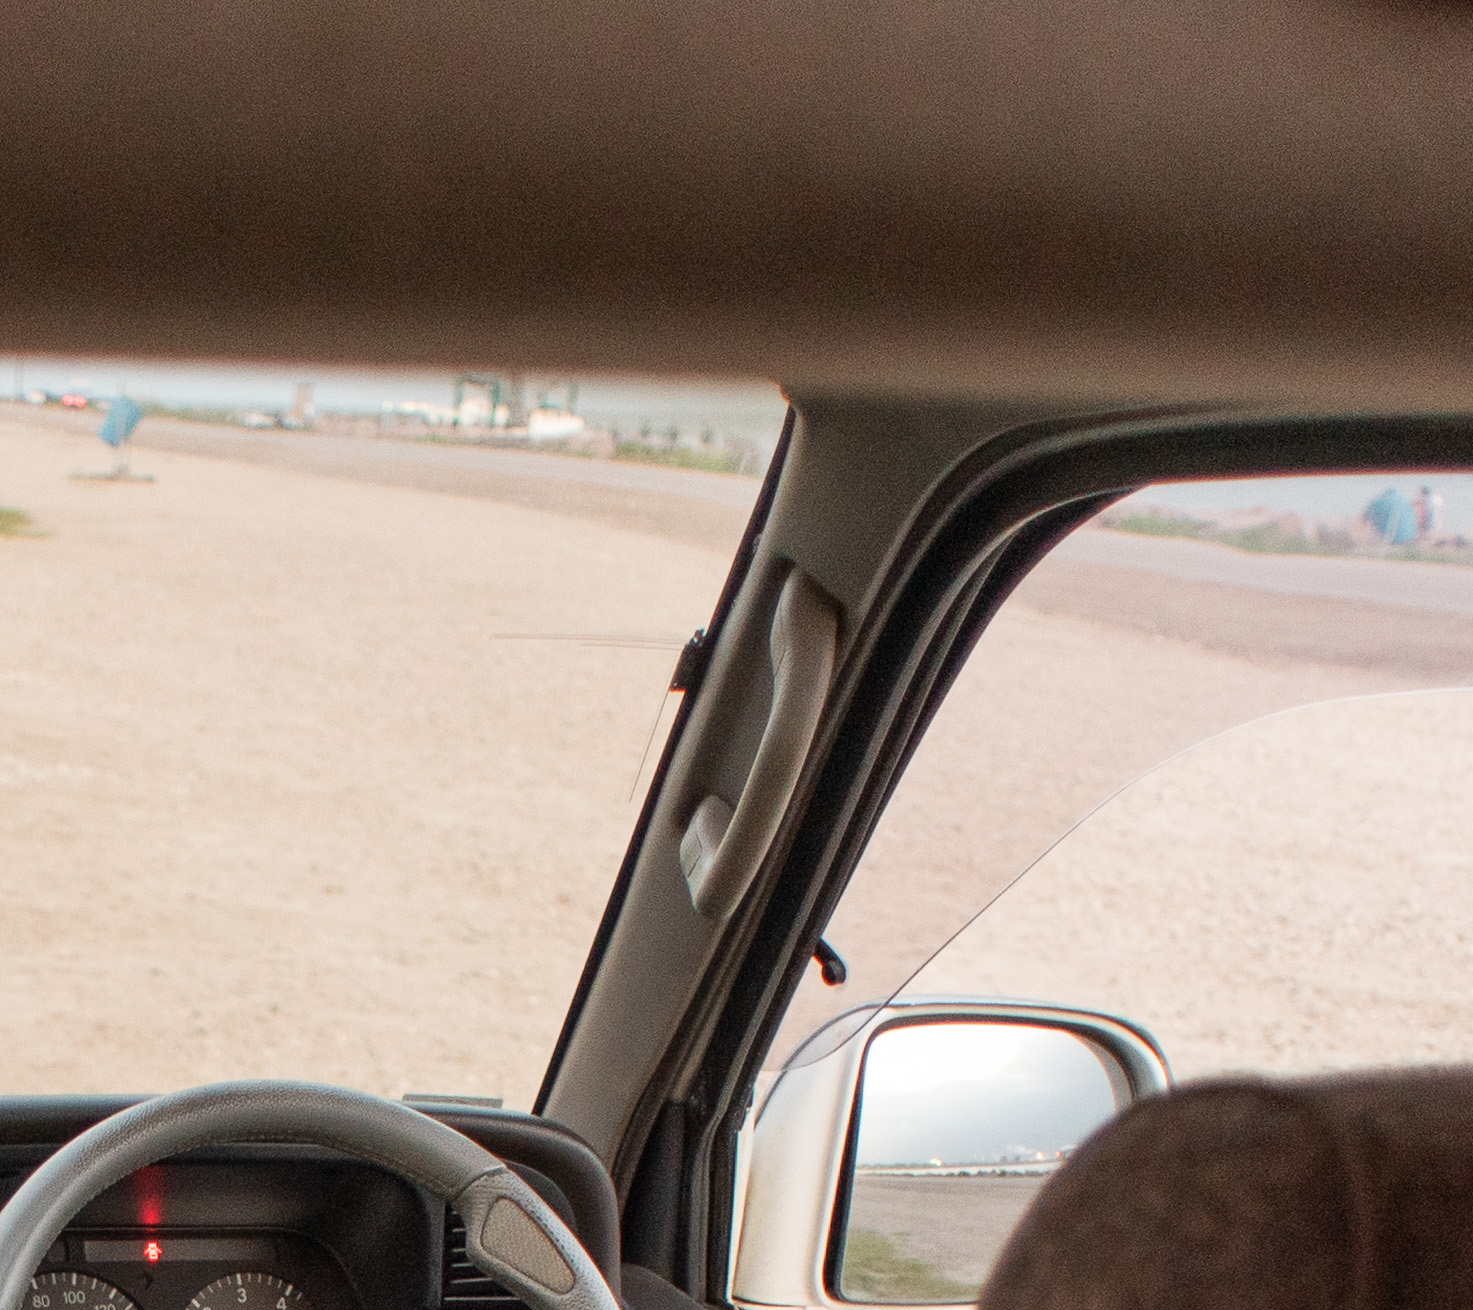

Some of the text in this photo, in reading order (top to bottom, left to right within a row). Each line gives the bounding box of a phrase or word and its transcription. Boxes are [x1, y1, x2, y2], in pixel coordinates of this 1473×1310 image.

[32, 1294, 51, 1308] 80
[62, 1290, 87, 1305] 100
[235, 1286, 248, 1304] 3
